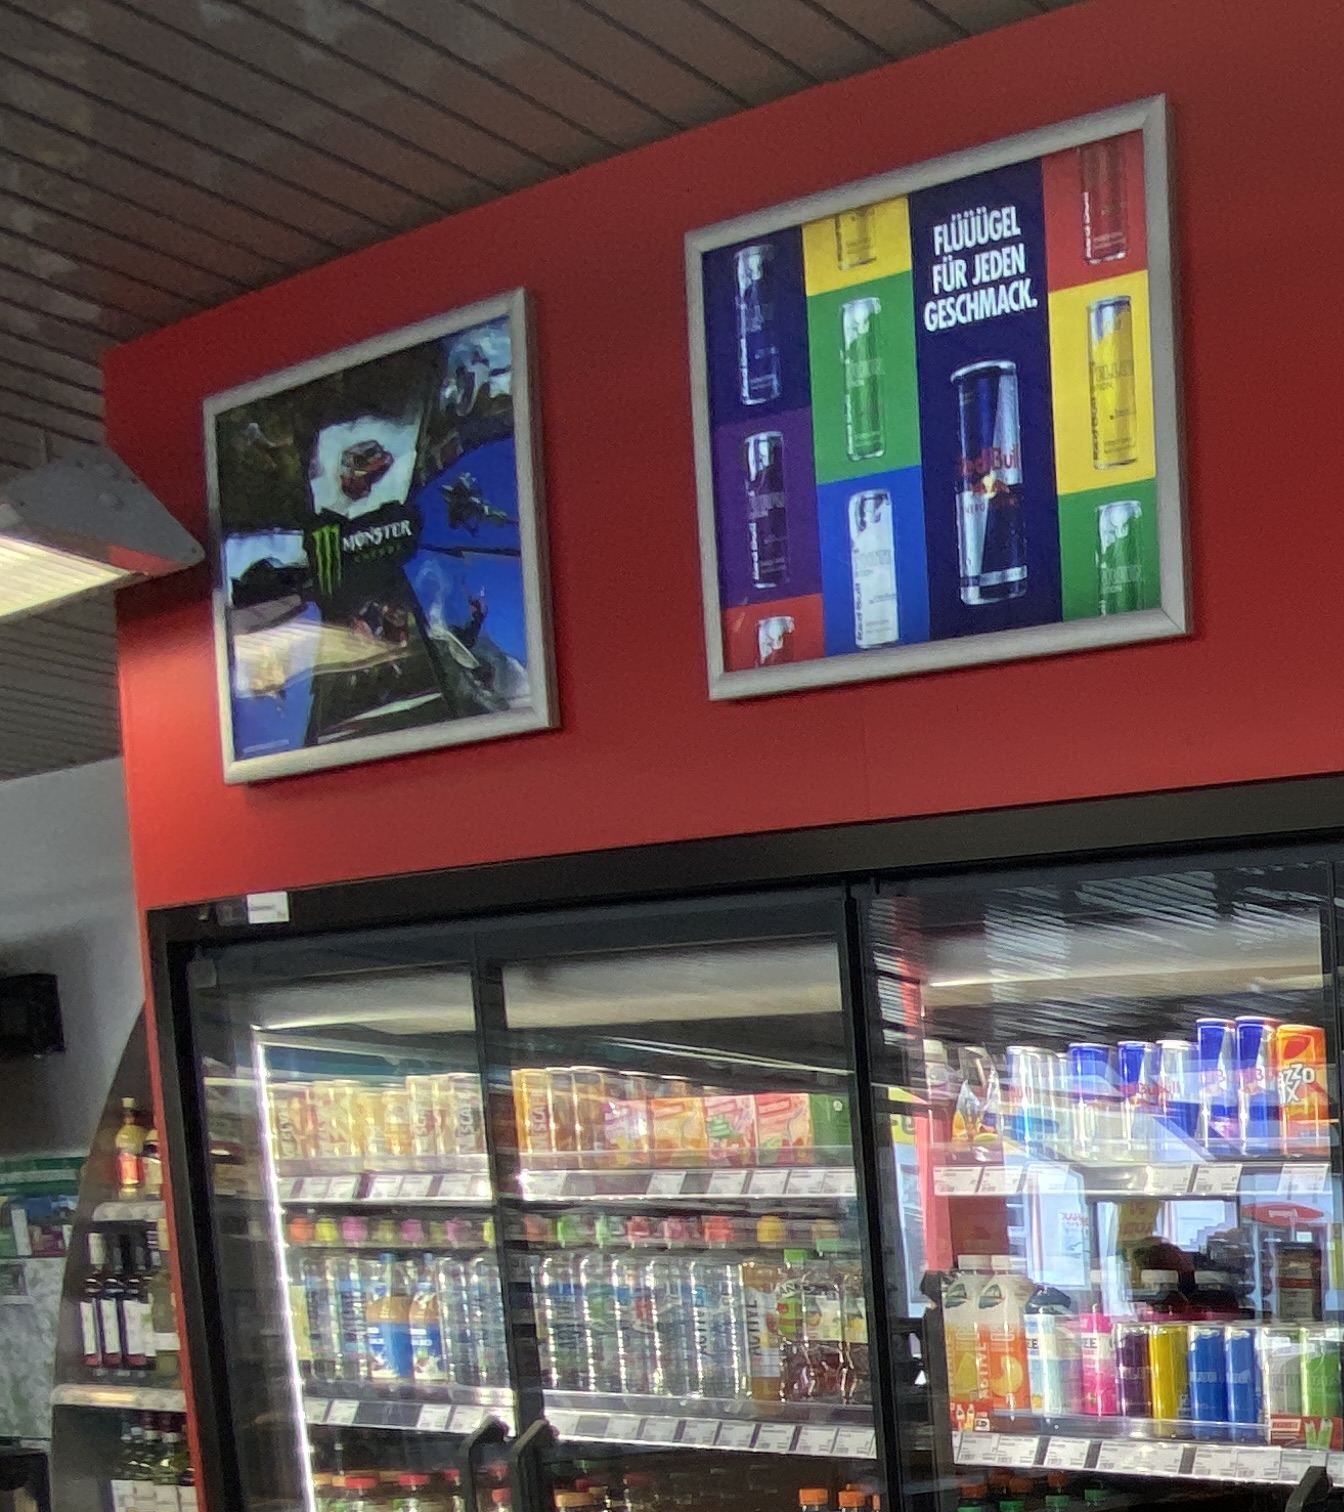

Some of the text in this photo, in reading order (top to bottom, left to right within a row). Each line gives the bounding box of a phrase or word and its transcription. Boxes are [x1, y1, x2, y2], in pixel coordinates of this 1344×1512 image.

[933, 206, 1021, 256] FLÜÜÜGEL
[932, 243, 1025, 295] FÜR JEDEN
[924, 278, 1039, 332] GESCHMACK.
[342, 519, 413, 552] MONSTER
